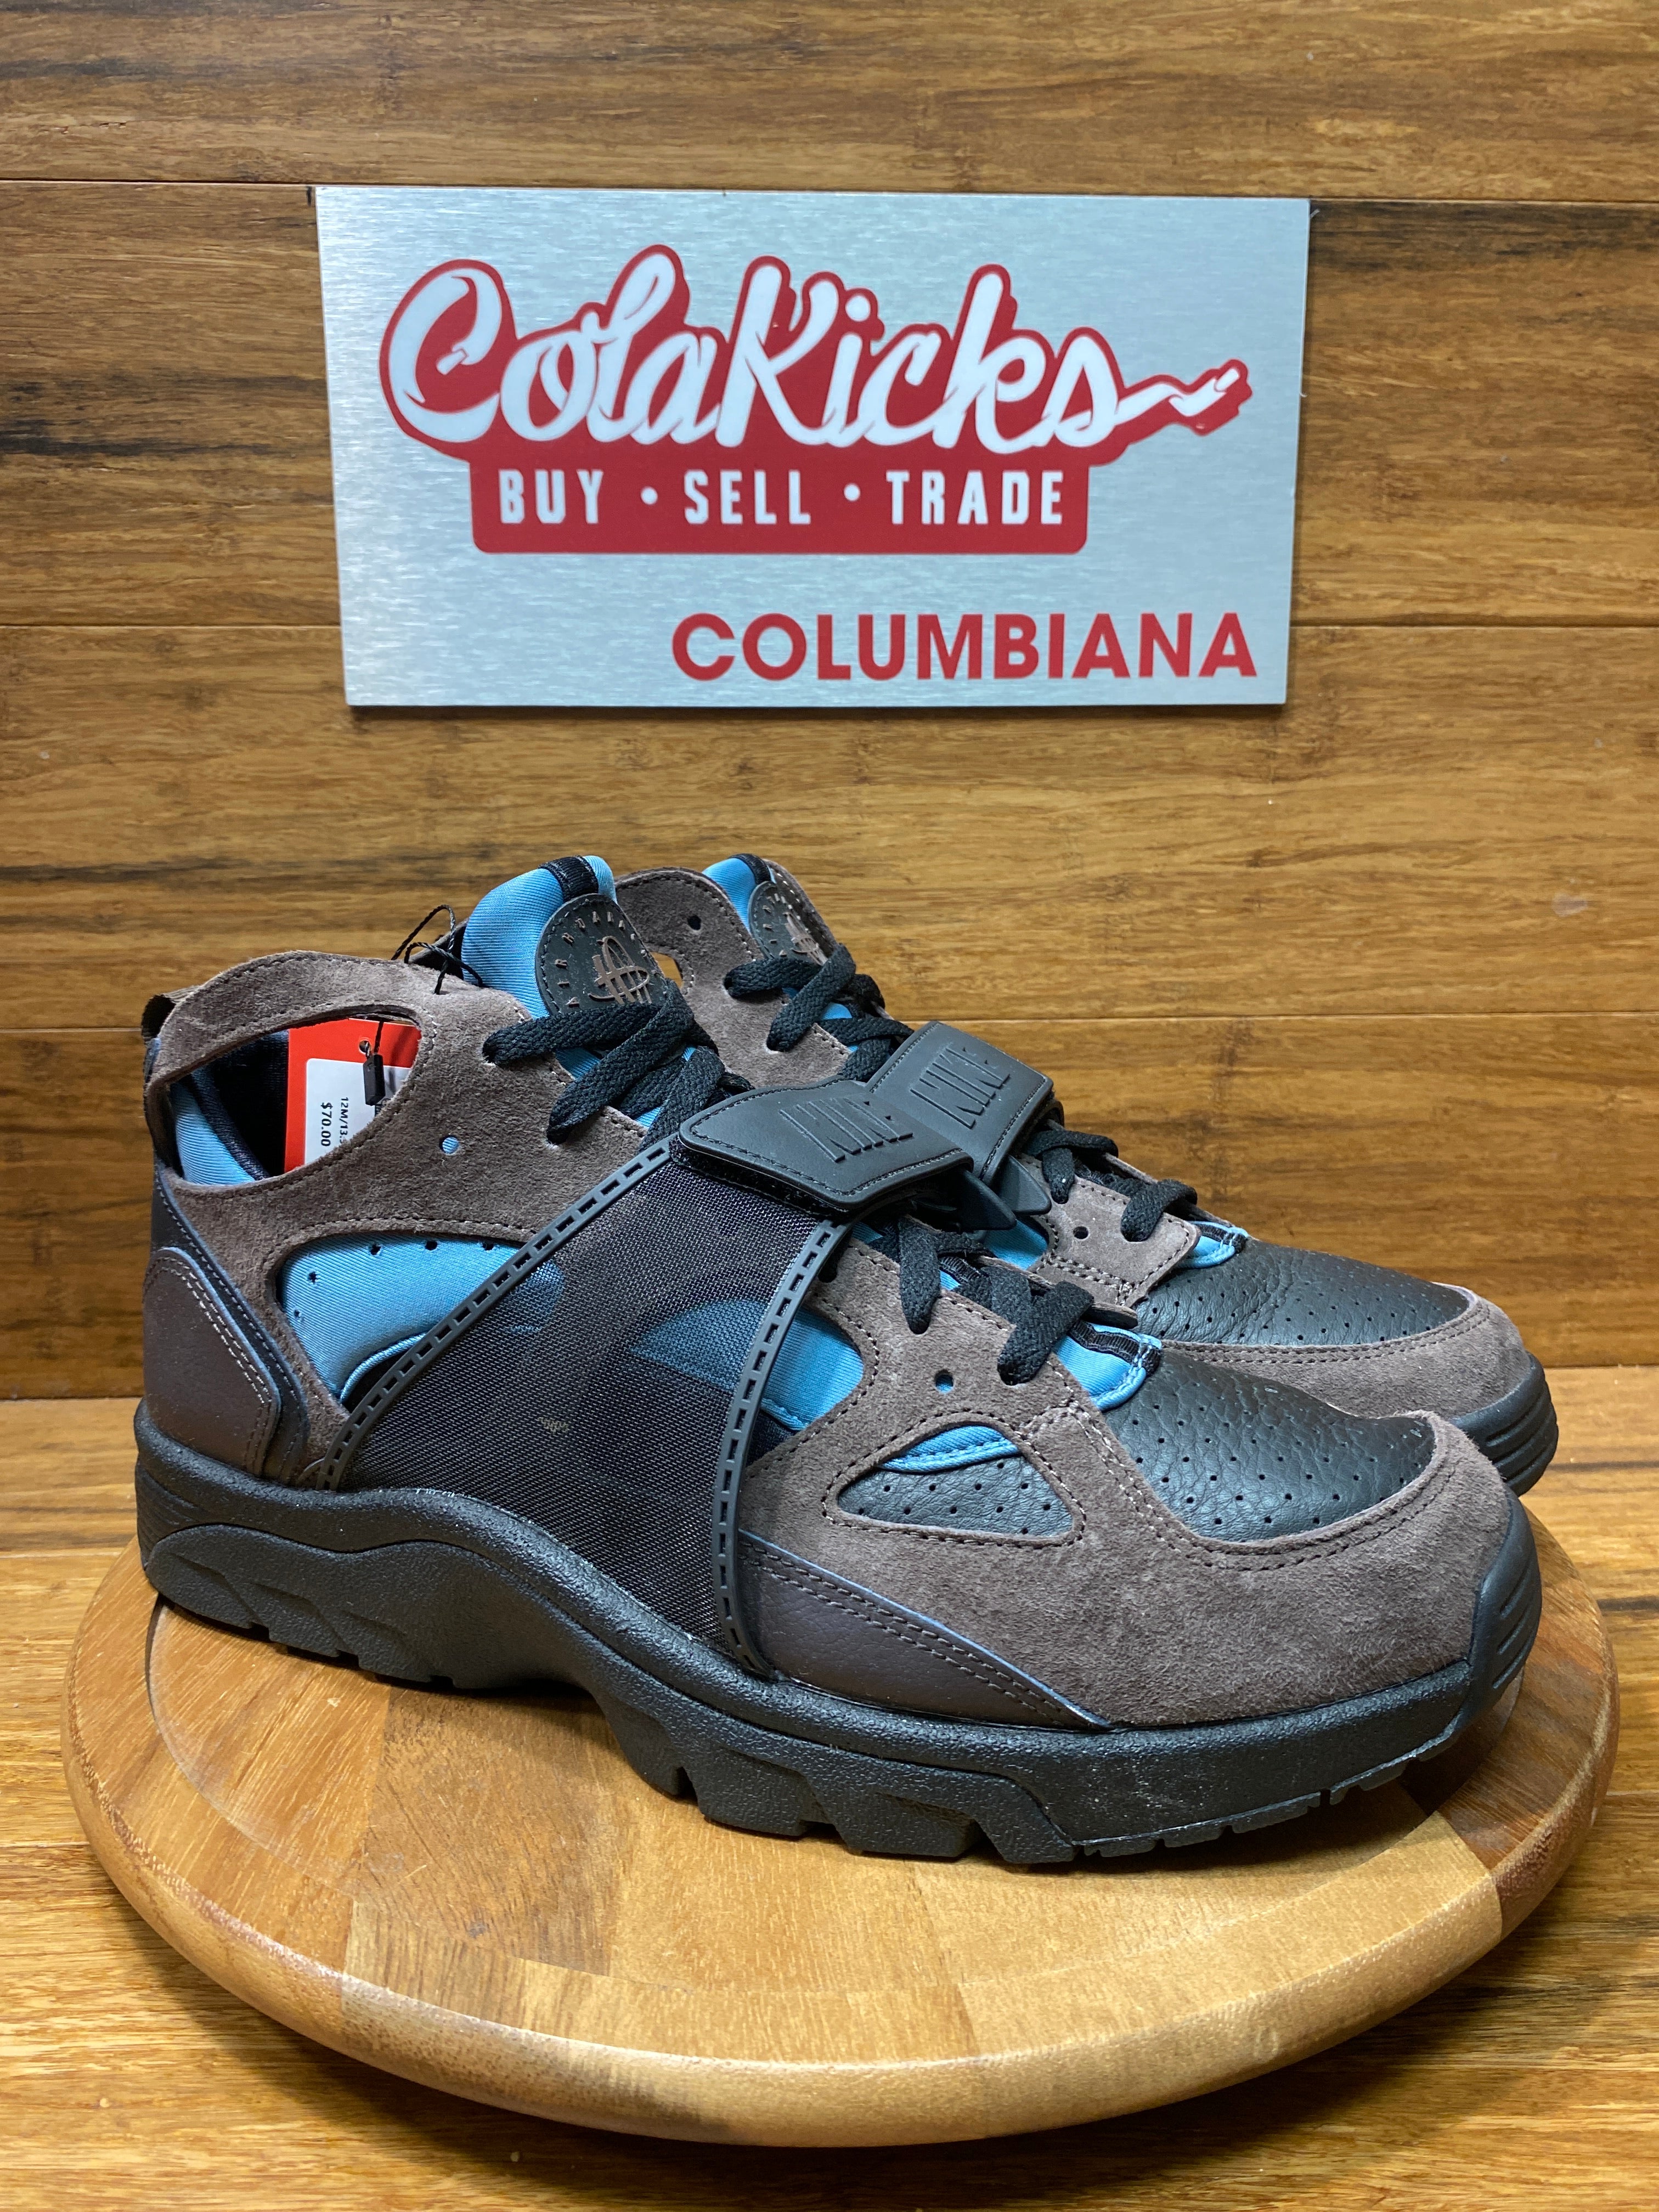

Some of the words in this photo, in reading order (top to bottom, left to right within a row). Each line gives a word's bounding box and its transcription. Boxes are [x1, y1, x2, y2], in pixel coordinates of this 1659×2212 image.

[387, 250, 1241, 454] ColaKicks
[497, 469, 604, 525] BUY
[684, 469, 811, 525] SELL
[886, 470, 1064, 525] TRADE
[673, 612, 1257, 681] COLUMBIANA
[320, 1102, 334, 1147] $70.00
